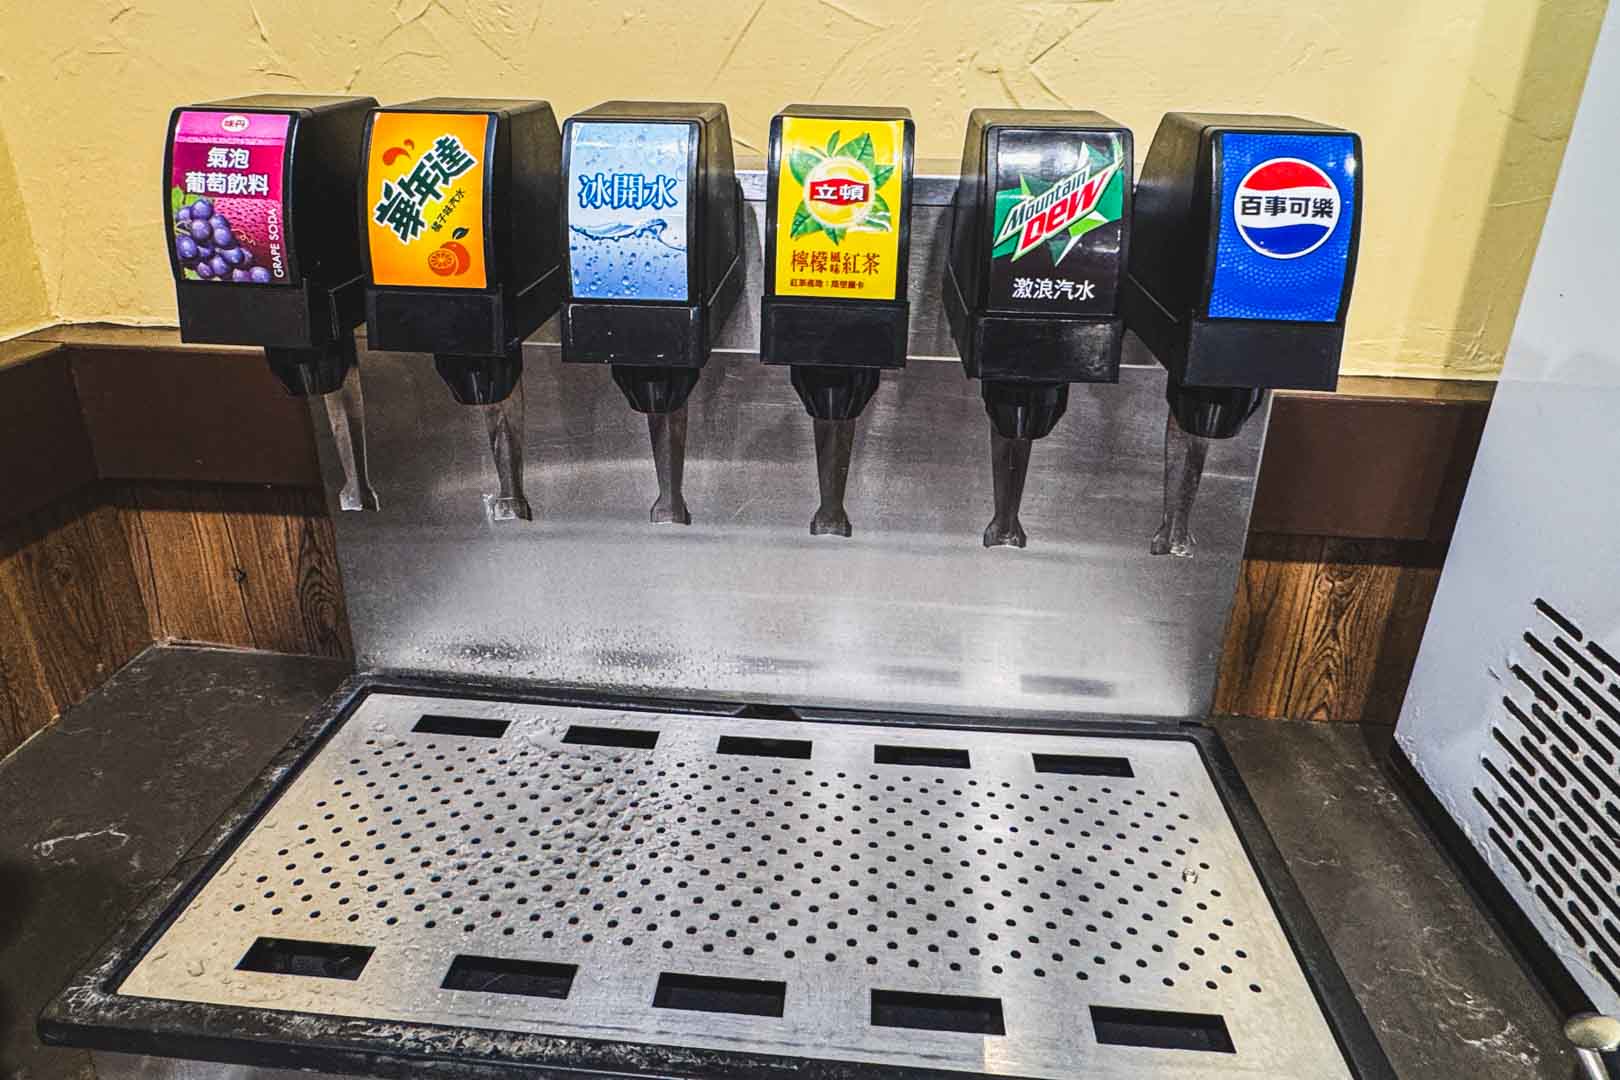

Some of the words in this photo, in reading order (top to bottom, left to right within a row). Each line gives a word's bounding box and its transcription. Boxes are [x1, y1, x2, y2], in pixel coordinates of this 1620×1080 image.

[207, 147, 249, 169] 氣泡
[185, 171, 269, 196] 葡萄飲料
[578, 172, 677, 210] 冰開水
[813, 183, 865, 201] 立頓
[1003, 171, 1087, 236] Mountain
[1240, 195, 1334, 219] 百事可樂
[268, 208, 280, 240] SODA
[270, 243, 284, 278] GRAPE
[1012, 278, 1096, 301] 激浪汽水
